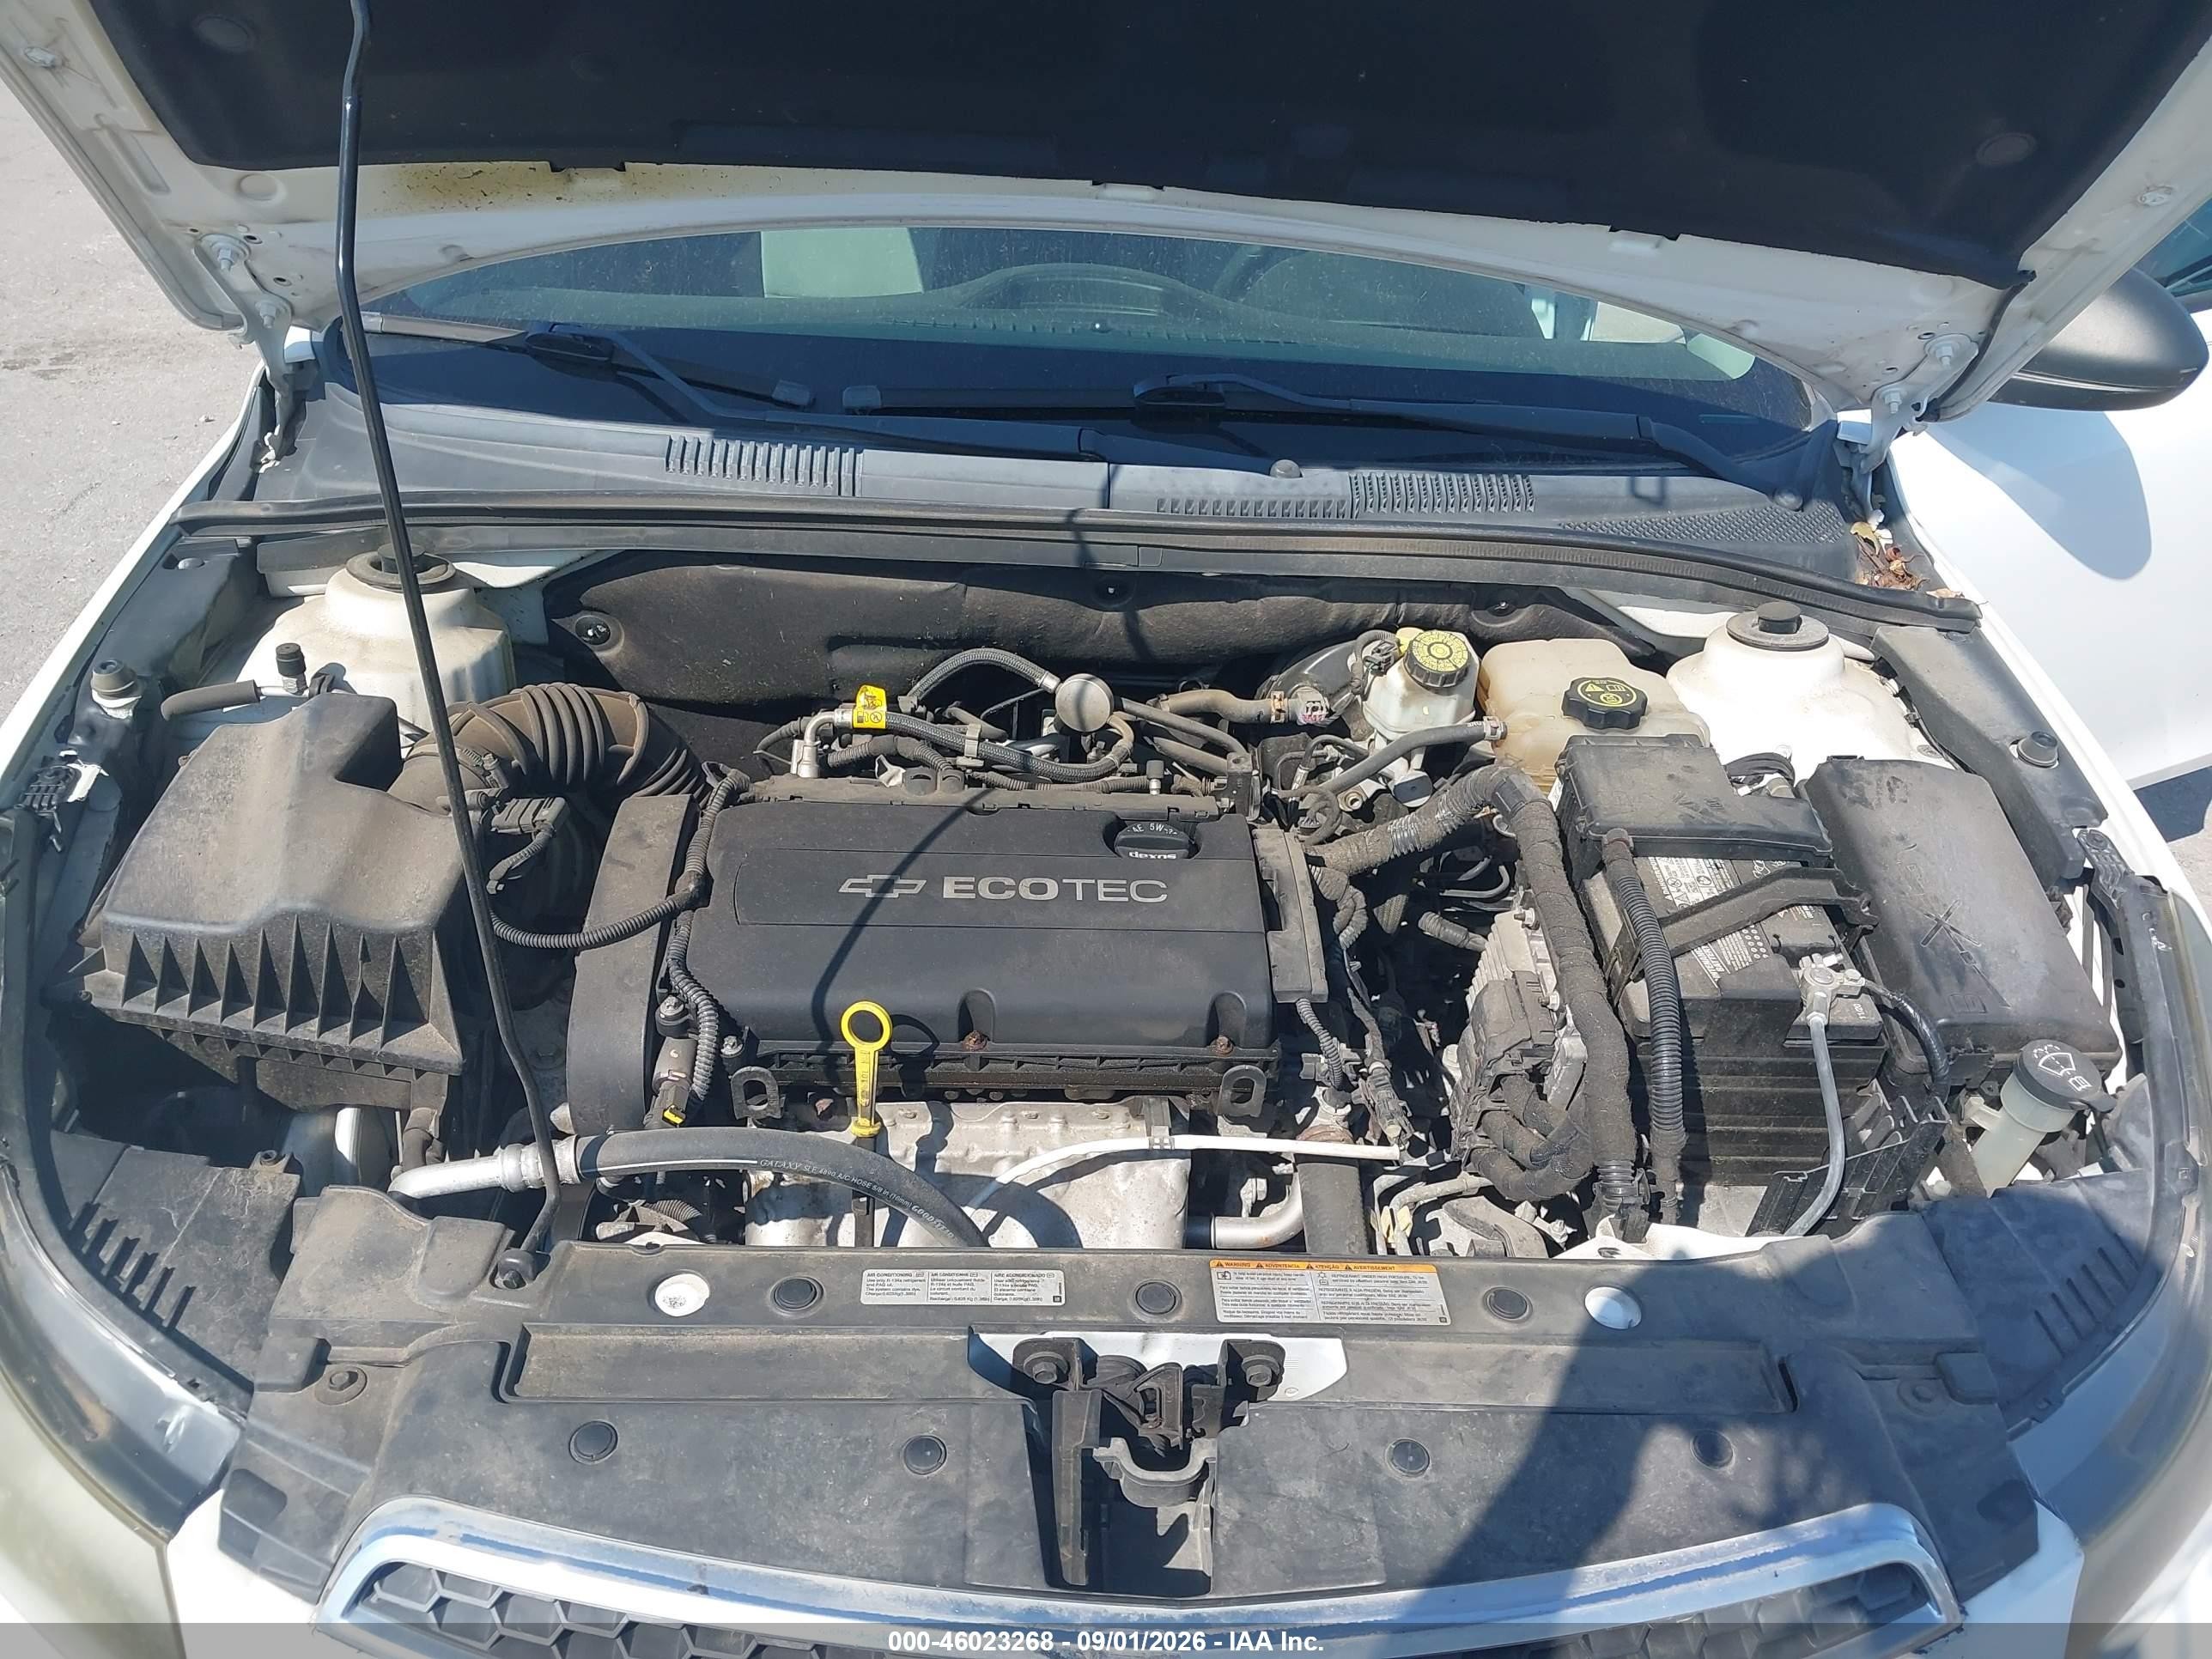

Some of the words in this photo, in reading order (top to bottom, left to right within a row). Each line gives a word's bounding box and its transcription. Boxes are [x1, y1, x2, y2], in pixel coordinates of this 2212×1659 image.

[1127, 823, 1144, 832] AE
[943, 876, 1168, 902] ECOTEC
[1701, 945, 1725, 972] BATTERY
[760, 1159, 802, 1169] GALAXY
[836, 1173, 851, 1181] A/C
[851, 1177, 872, 1188] HOSE
[882, 1188, 890, 1196] in
[889, 1193, 913, 1208] (16mm)
